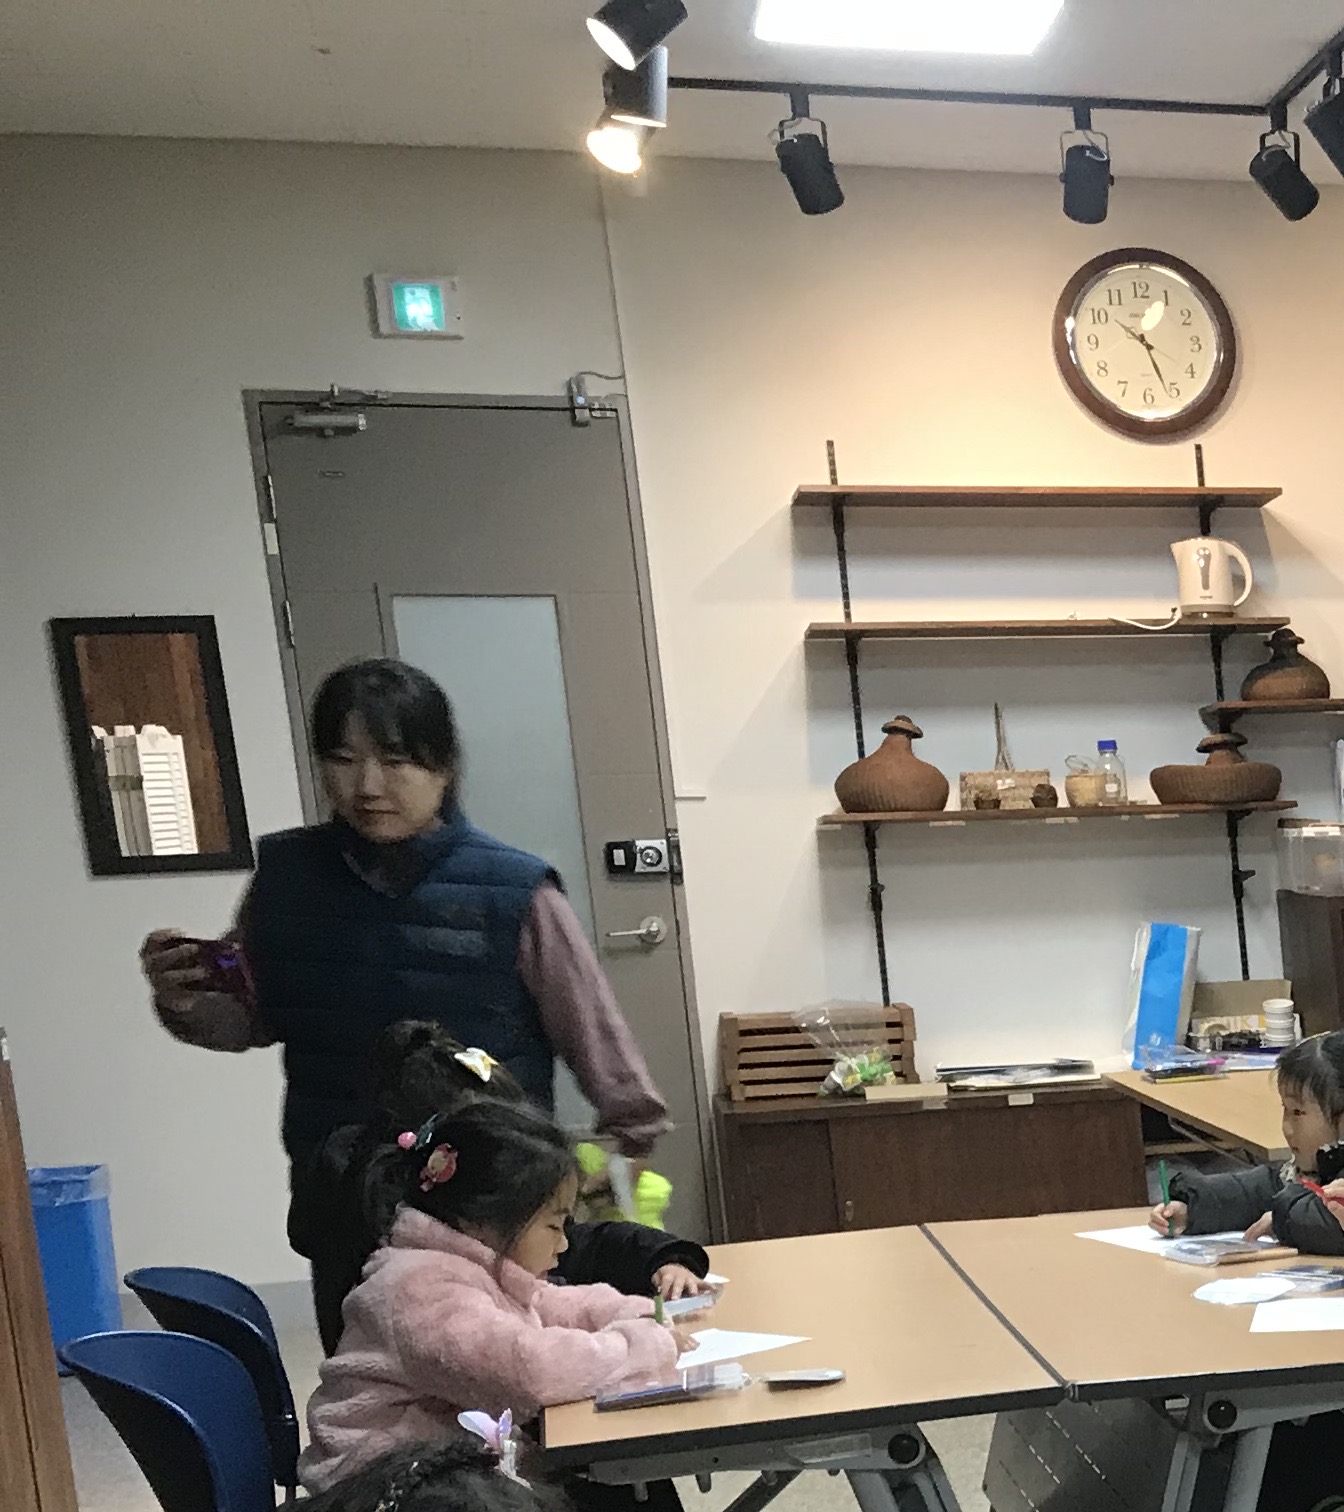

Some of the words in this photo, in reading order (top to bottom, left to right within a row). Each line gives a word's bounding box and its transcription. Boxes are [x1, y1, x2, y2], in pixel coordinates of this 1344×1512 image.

[1107, 288, 1123, 306] 11
[1132, 281, 1150, 299] 12
[1163, 289, 1169, 307] 1
[1090, 307, 1109, 325] 10
[1180, 308, 1192, 326] 2
[1087, 333, 1099, 351] 9
[1189, 335, 1202, 353] 3
[1096, 360, 1109, 377] 8
[1184, 362, 1196, 379] 4
[1117, 380, 1128, 398] 7
[1143, 387, 1155, 405] 6
[1168, 381, 1181, 399] 5
